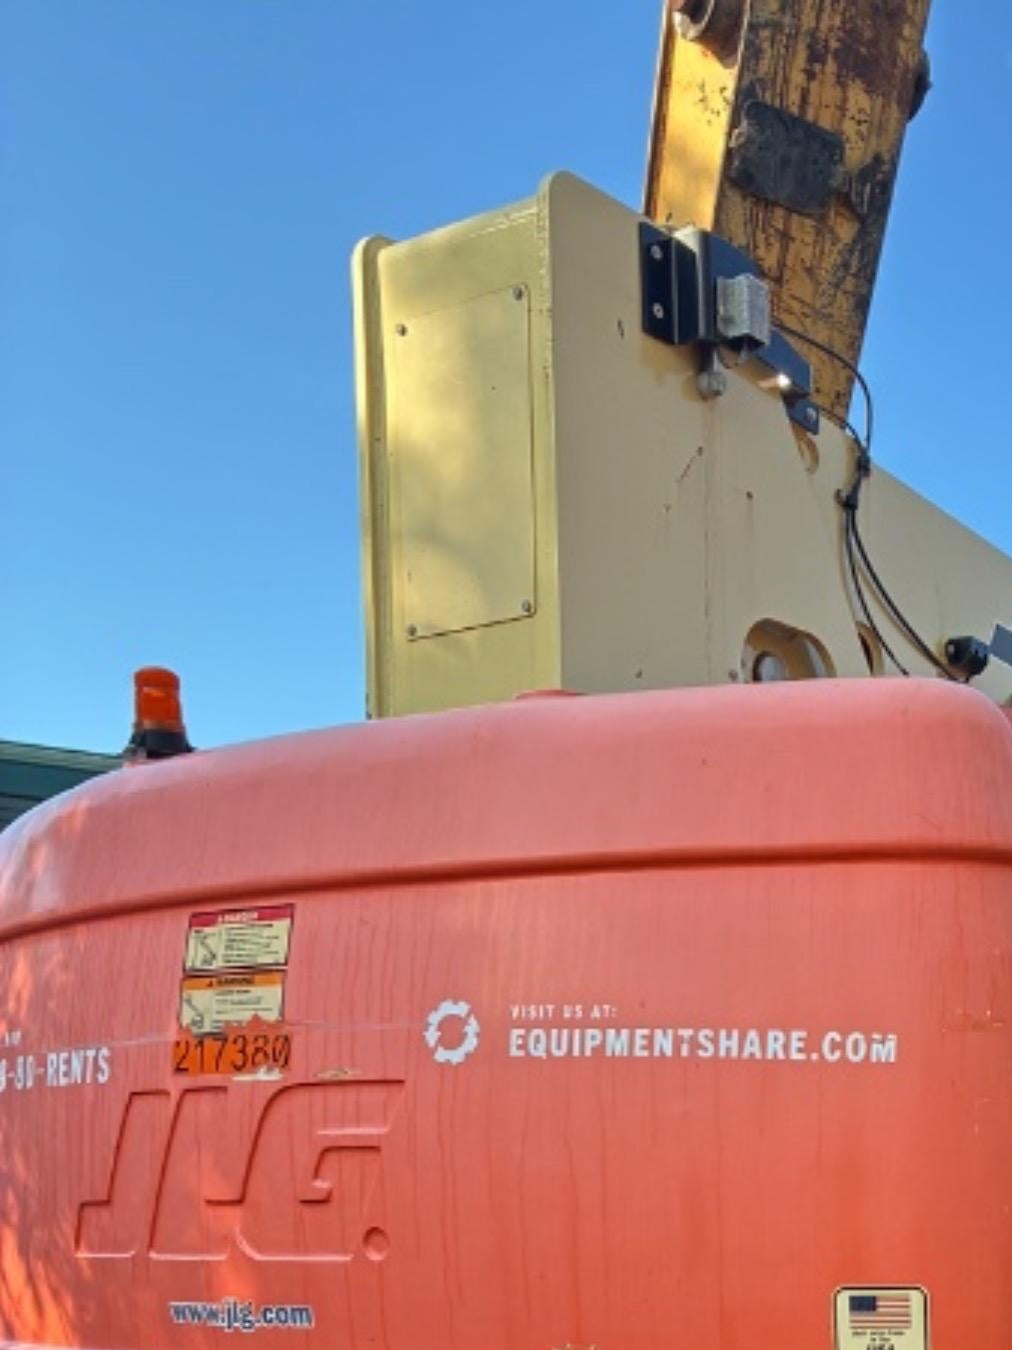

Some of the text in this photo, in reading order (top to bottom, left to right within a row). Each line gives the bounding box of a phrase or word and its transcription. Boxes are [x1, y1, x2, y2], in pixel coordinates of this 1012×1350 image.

[509, 1004, 555, 1020] VISIT
[563, 1004, 583, 1019] US
[509, 1026, 898, 1064] EQUIPMENTSHARE.COM
[169, 1297, 315, 1333] www.jlg.com
